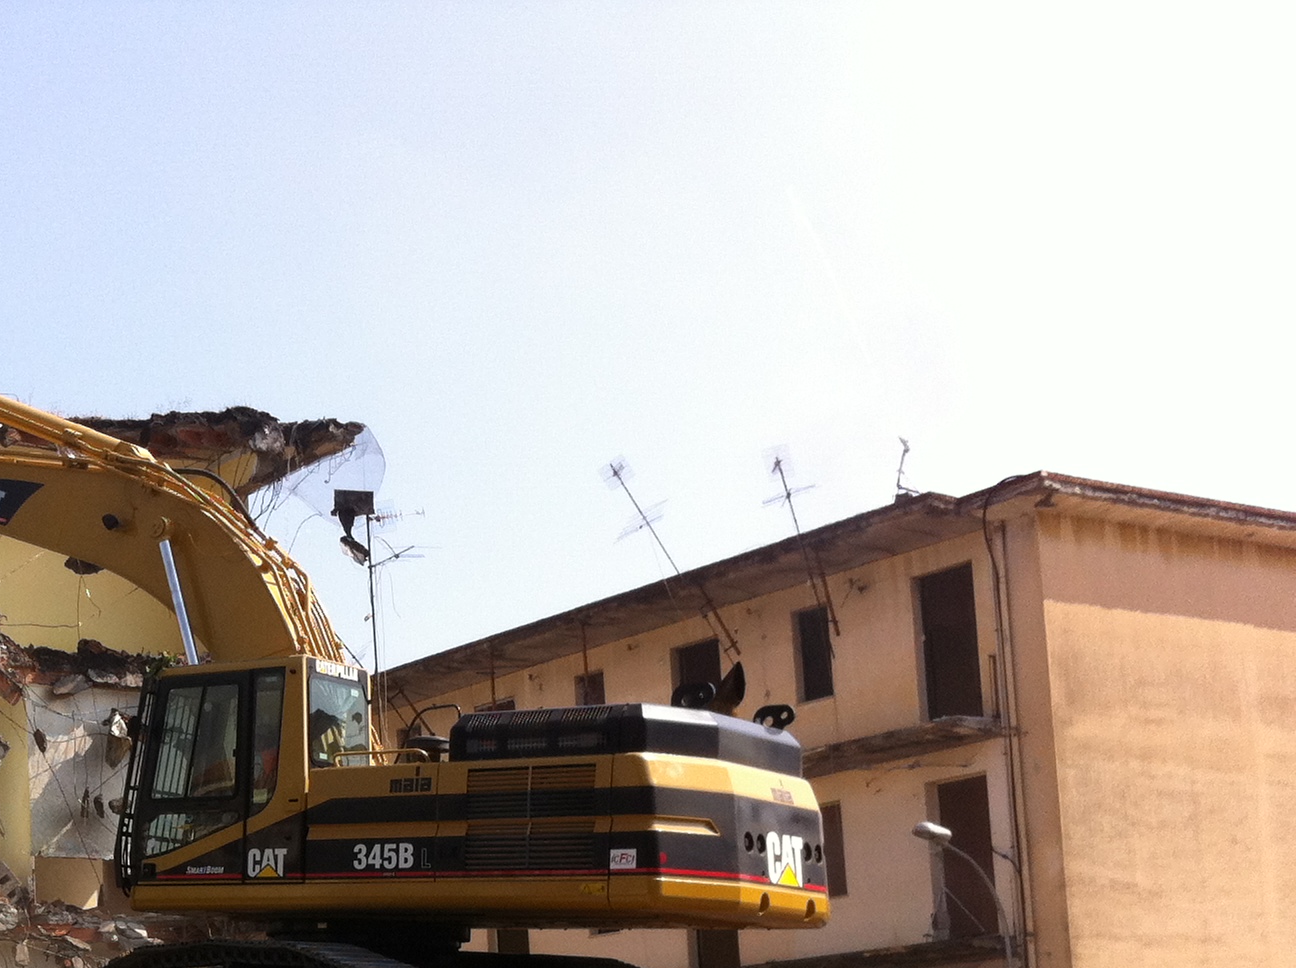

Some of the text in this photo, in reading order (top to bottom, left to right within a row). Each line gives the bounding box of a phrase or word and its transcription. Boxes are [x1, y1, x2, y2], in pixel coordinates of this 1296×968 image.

[247, 848, 288, 878] CAT
[353, 842, 431, 870] 345B L
[766, 831, 803, 888] CAT
